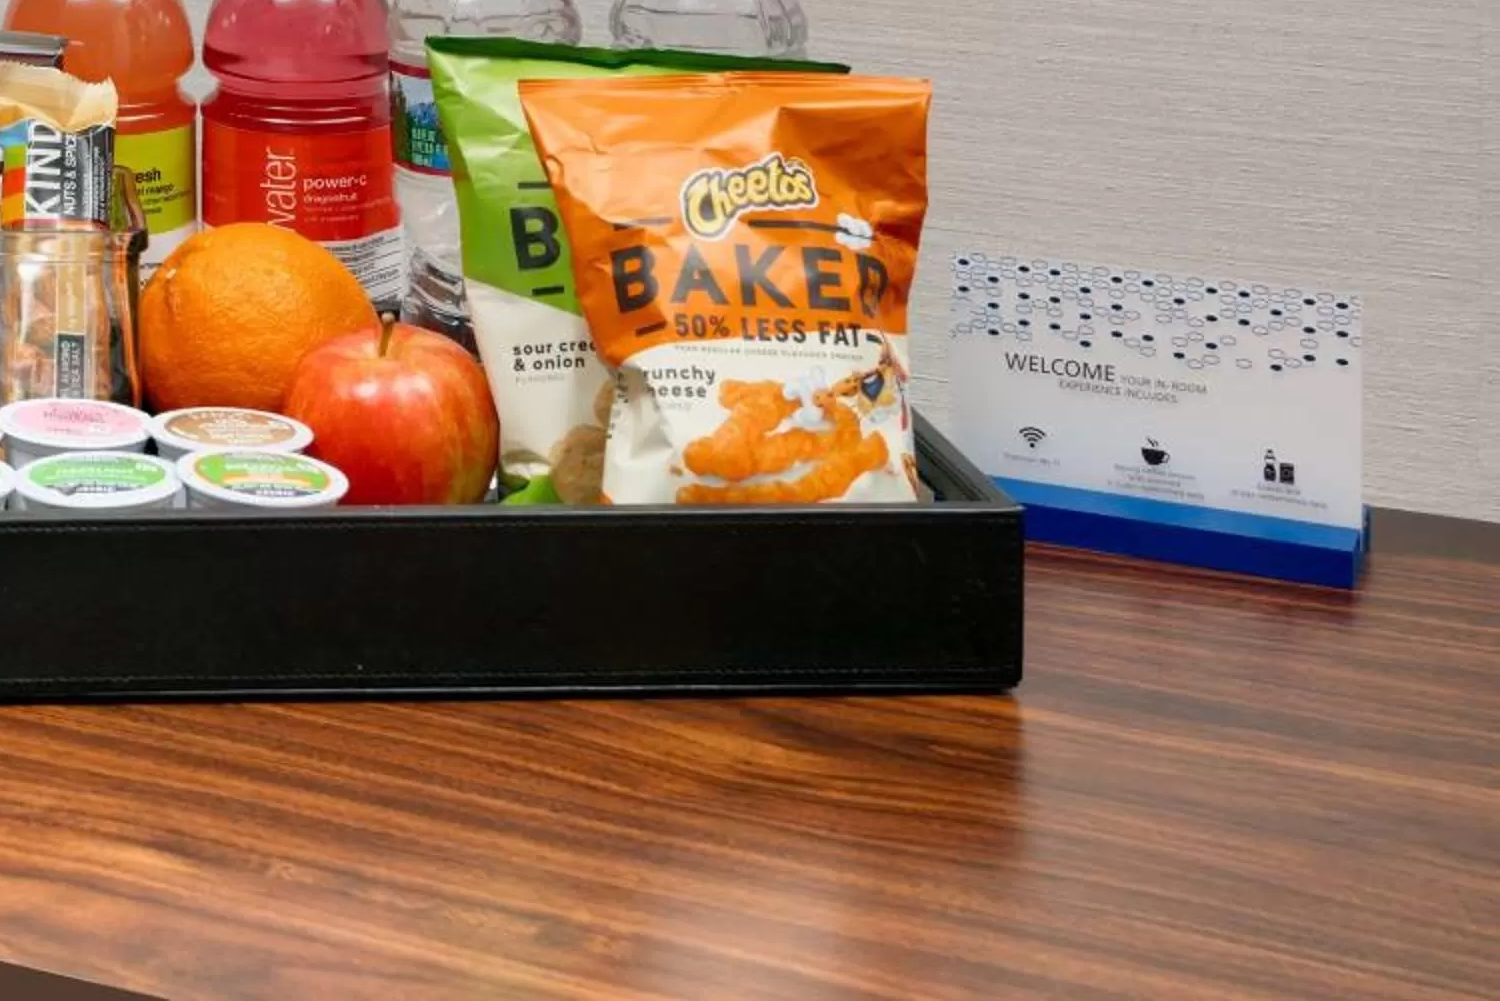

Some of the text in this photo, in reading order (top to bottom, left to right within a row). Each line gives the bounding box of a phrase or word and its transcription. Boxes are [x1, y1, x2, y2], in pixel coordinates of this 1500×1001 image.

[25, 122, 63, 219] KIND
[63, 133, 77, 216] NUTS & SPICE
[303, 174, 368, 192] power-c
[684, 156, 815, 237] Cheetos
[674, 313, 862, 348] 50% LESS FAT
[512, 342, 552, 356] sour
[513, 354, 585, 371] & onion
[643, 365, 716, 386] runchy
[1005, 352, 1116, 383] WELCOME
[1121, 374, 1151, 387] YOUR
[646, 384, 707, 398] heese
